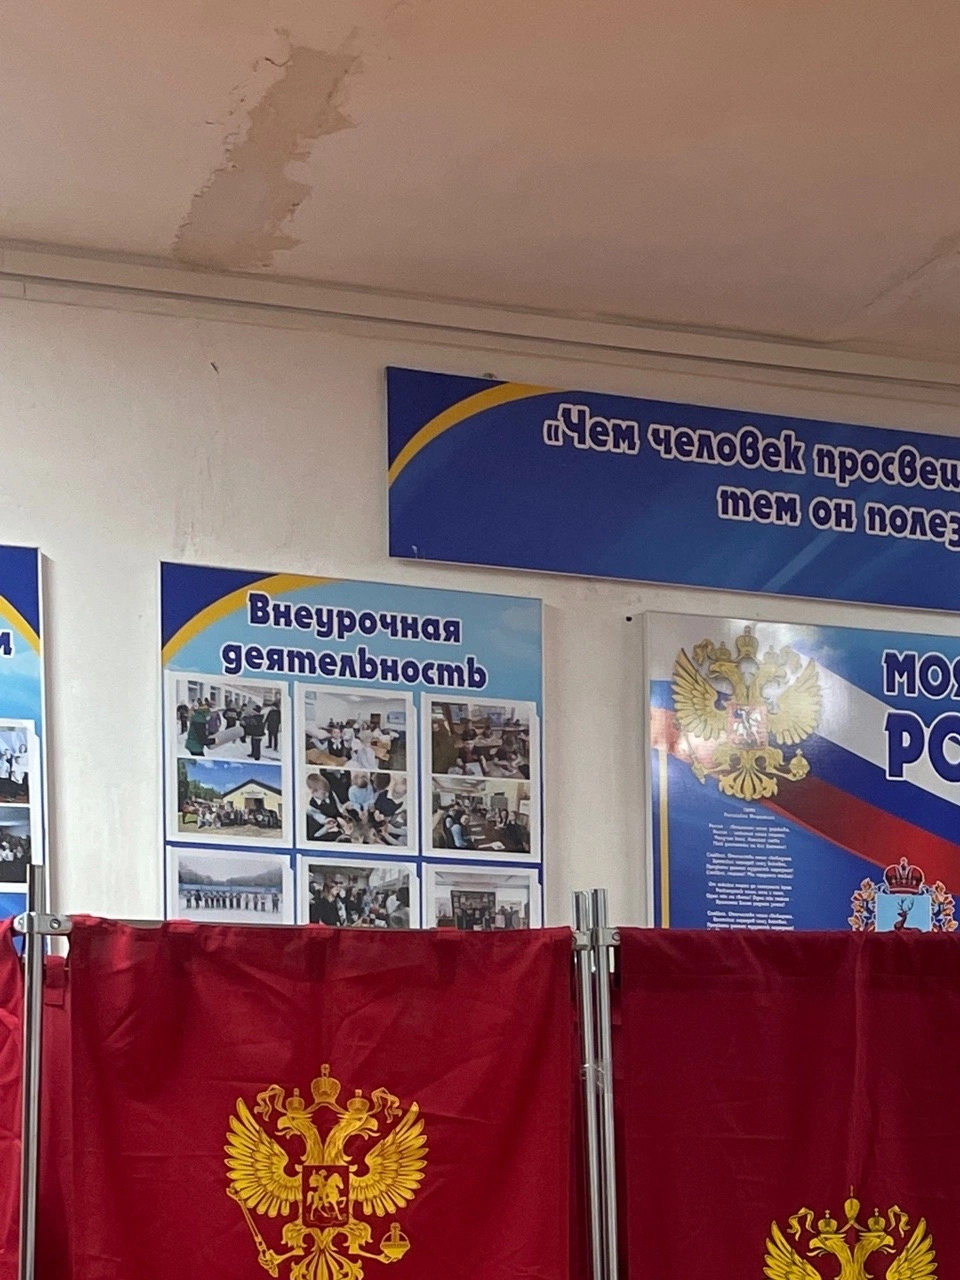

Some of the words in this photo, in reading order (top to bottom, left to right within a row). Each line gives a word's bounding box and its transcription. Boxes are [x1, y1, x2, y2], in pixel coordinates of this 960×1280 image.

[648, 425, 804, 474] человек
[717, 485, 801, 526] тем
[810, 498, 855, 533] он
[247, 590, 462, 646] Внеурочная
[220, 640, 488, 690] деятельность
